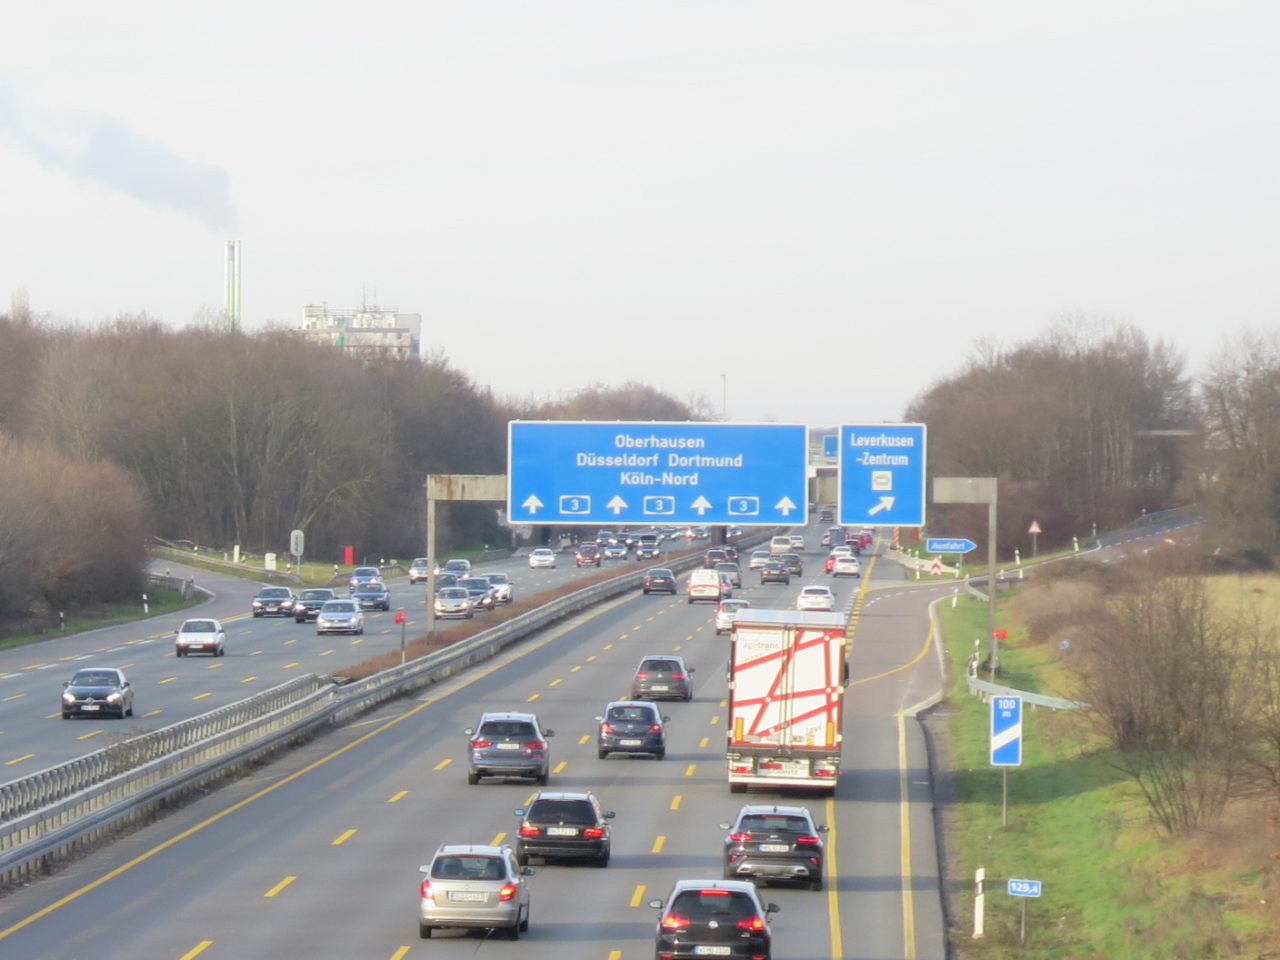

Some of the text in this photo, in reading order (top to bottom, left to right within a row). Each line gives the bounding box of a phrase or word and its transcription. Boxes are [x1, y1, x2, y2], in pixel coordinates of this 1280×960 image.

[614, 434, 705, 448] Oberhausen
[850, 432, 914, 447] Leverkusen
[576, 452, 743, 467] Düsseldorf Dortmund
[856, 451, 909, 466] -Zentrum
[620, 471, 699, 486] Köln-Nord
[570, 499, 580, 511] 3
[655, 499, 665, 511] 3
[739, 500, 749, 512] 3
[998, 698, 1016, 710] 100
